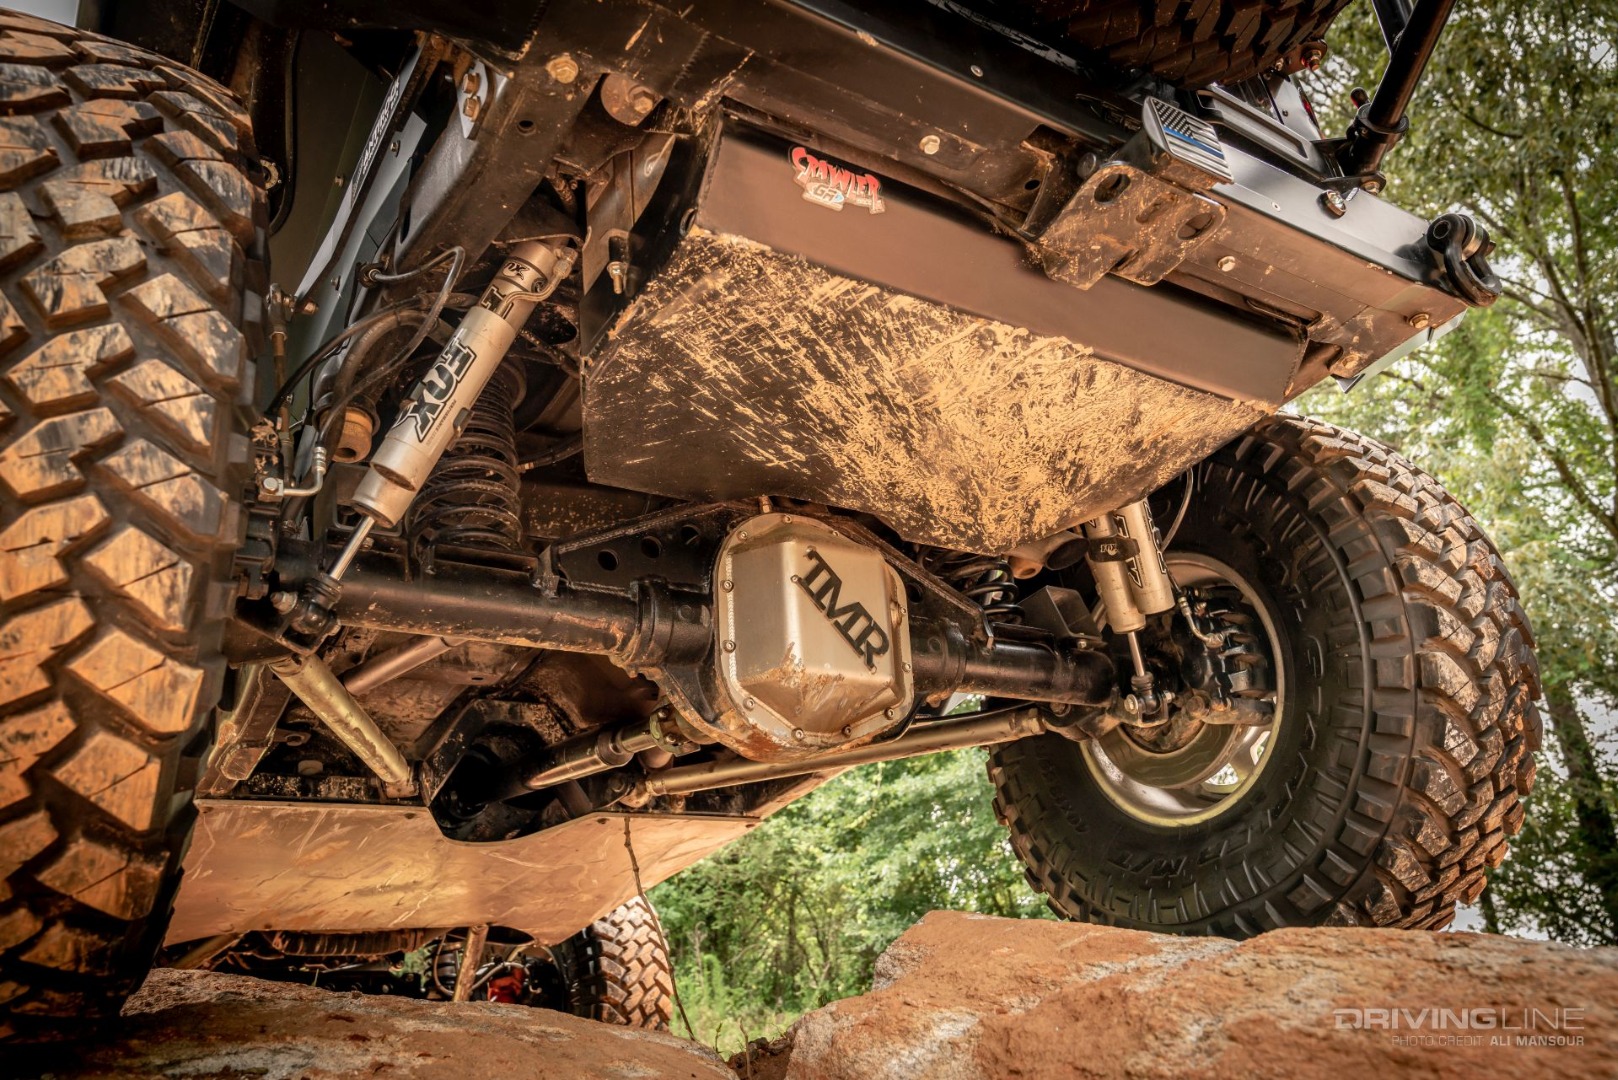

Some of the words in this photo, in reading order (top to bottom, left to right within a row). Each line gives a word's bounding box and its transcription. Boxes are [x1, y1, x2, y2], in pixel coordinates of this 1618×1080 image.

[792, 146, 884, 212] CRAWLER
[501, 261, 531, 281] OX
[392, 330, 477, 443] FOX
